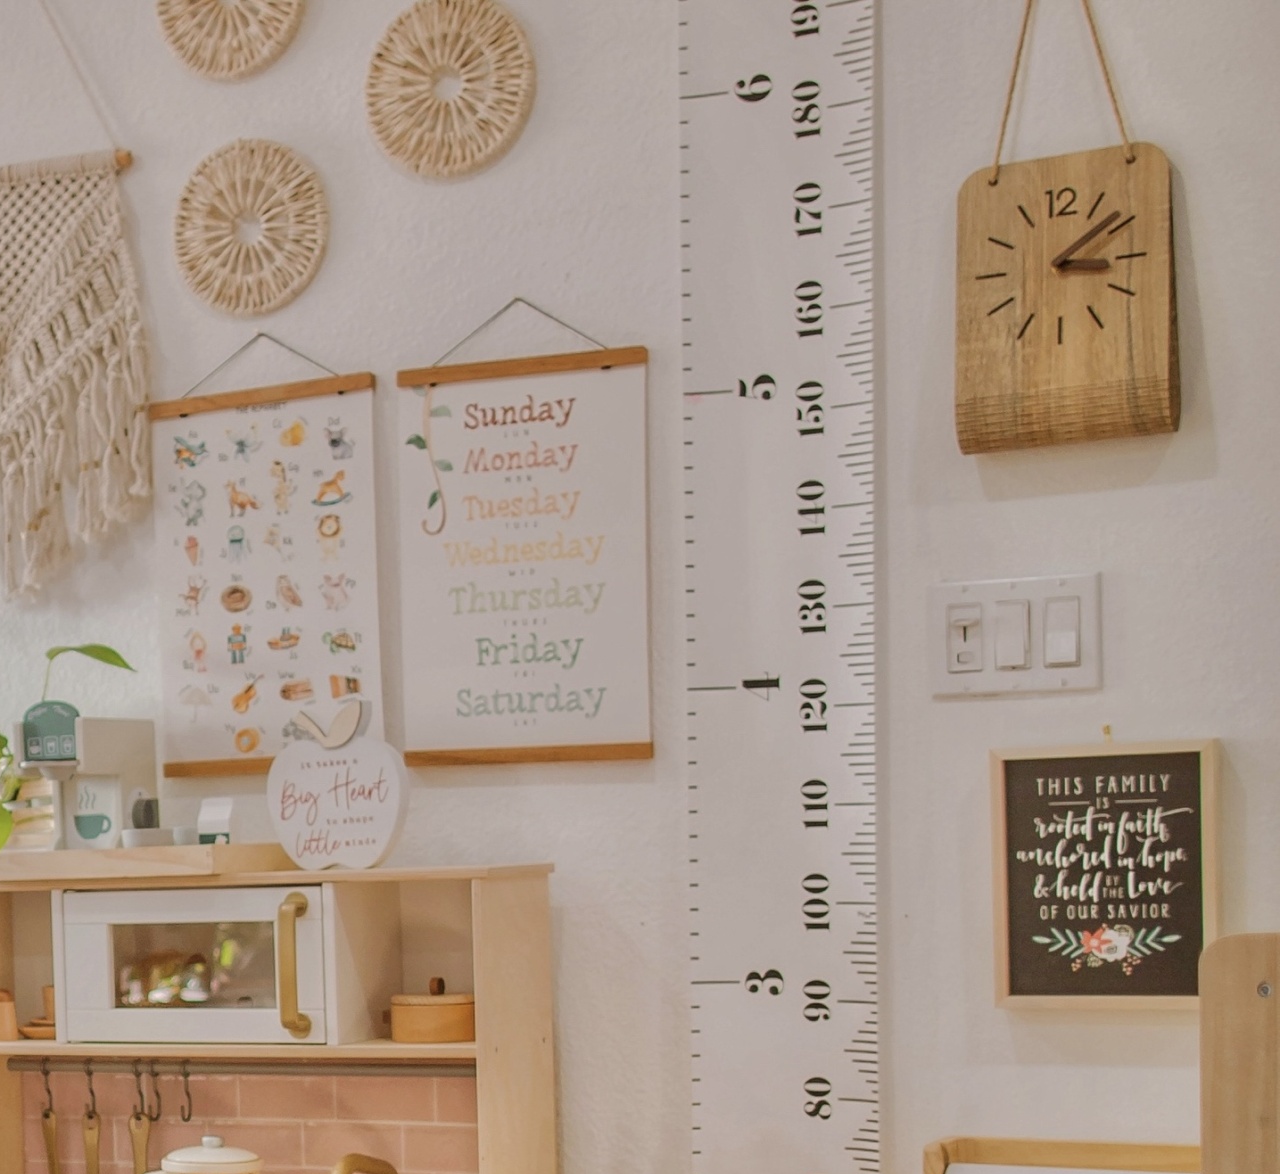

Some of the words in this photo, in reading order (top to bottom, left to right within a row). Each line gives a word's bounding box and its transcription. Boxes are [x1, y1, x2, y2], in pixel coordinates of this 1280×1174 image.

[791, 0, 819, 37] 19
[734, 73, 773, 102] 6
[791, 80, 821, 139] 180
[793, 182, 823, 237] 170
[1044, 187, 1078, 219] 12
[794, 280, 824, 338] 160
[737, 374, 777, 401] 5
[464, 395, 576, 430] Sunday
[795, 381, 825, 437] 150
[463, 441, 579, 474] Monday
[462, 487, 581, 521] Tuesday
[796, 479, 826, 537] 140
[443, 531, 606, 567] Wednesday
[448, 577, 606, 615] Thursday
[797, 579, 827, 634] 130
[475, 632, 584, 670] Friday
[456, 683, 607, 719] Saturday
[742, 671, 781, 702] 4
[799, 678, 828, 734] 120
[281, 779, 320, 826] Big
[327, 767, 390, 811] Heart
[1036, 776, 1084, 796] THIS
[1095, 774, 1171, 794] FAMILY
[1096, 797, 1110, 809] IS
[800, 779, 829, 830] 110
[1033, 806, 1112, 841] rooted
[1098, 821, 1115, 834] in
[1117, 806, 1194, 855] faith
[1016, 835, 1112, 870] anchored
[1118, 857, 1134, 869] in
[1033, 873, 1051, 898] &
[1050, 869, 1104, 903] hold
[1102, 887, 1124, 899] THE
[1106, 875, 1119, 886] BY
[801, 873, 830, 931] 100
[1040, 905, 1059, 920] OF
[1066, 904, 1099, 920] OUR
[1107, 903, 1171, 919] SAVIOR
[745, 968, 785, 996] 3
[802, 979, 831, 1023] 90
[803, 1076, 832, 1121] 80
